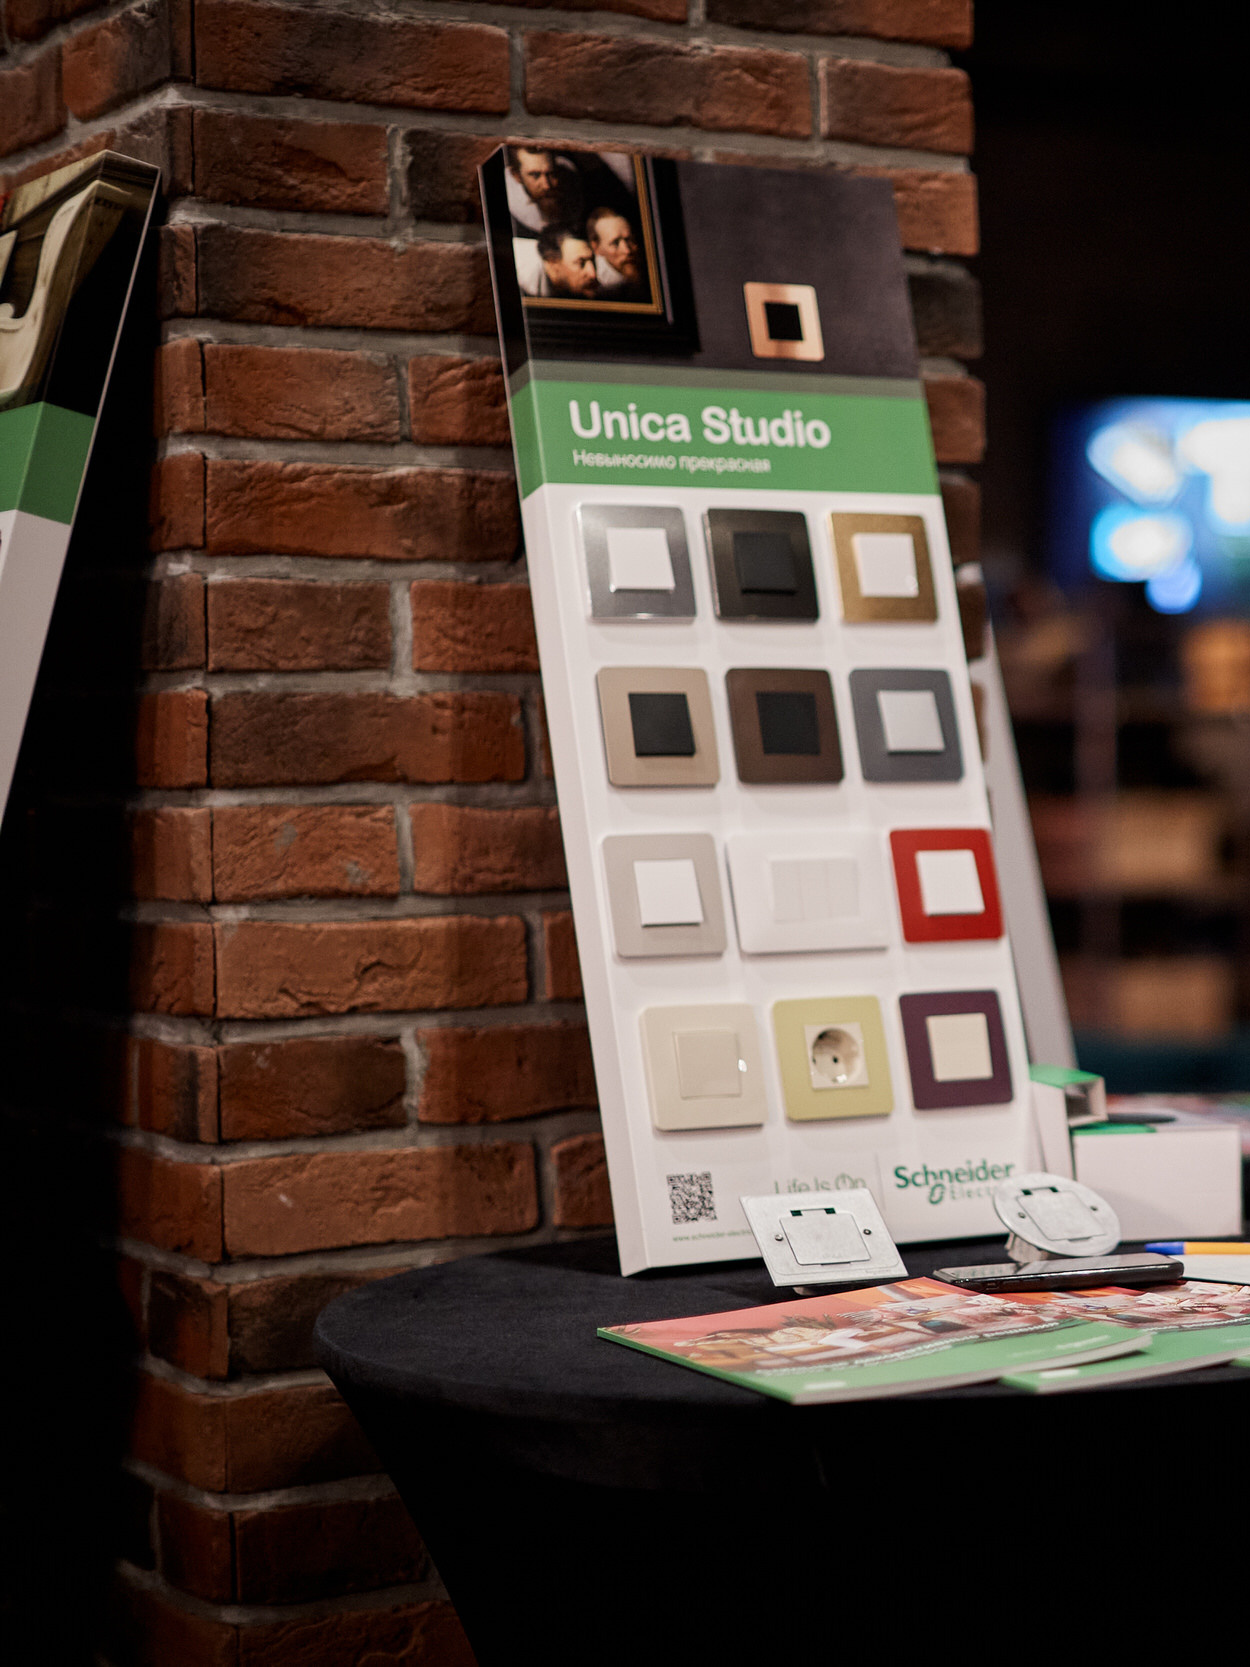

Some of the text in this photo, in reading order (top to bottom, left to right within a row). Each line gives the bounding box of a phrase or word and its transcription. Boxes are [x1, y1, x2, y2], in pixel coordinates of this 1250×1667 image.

[569, 400, 831, 448] Unica Studio
[572, 450, 771, 474] Невыносимо прекрасная
[894, 1158, 1015, 1189] Schneider
